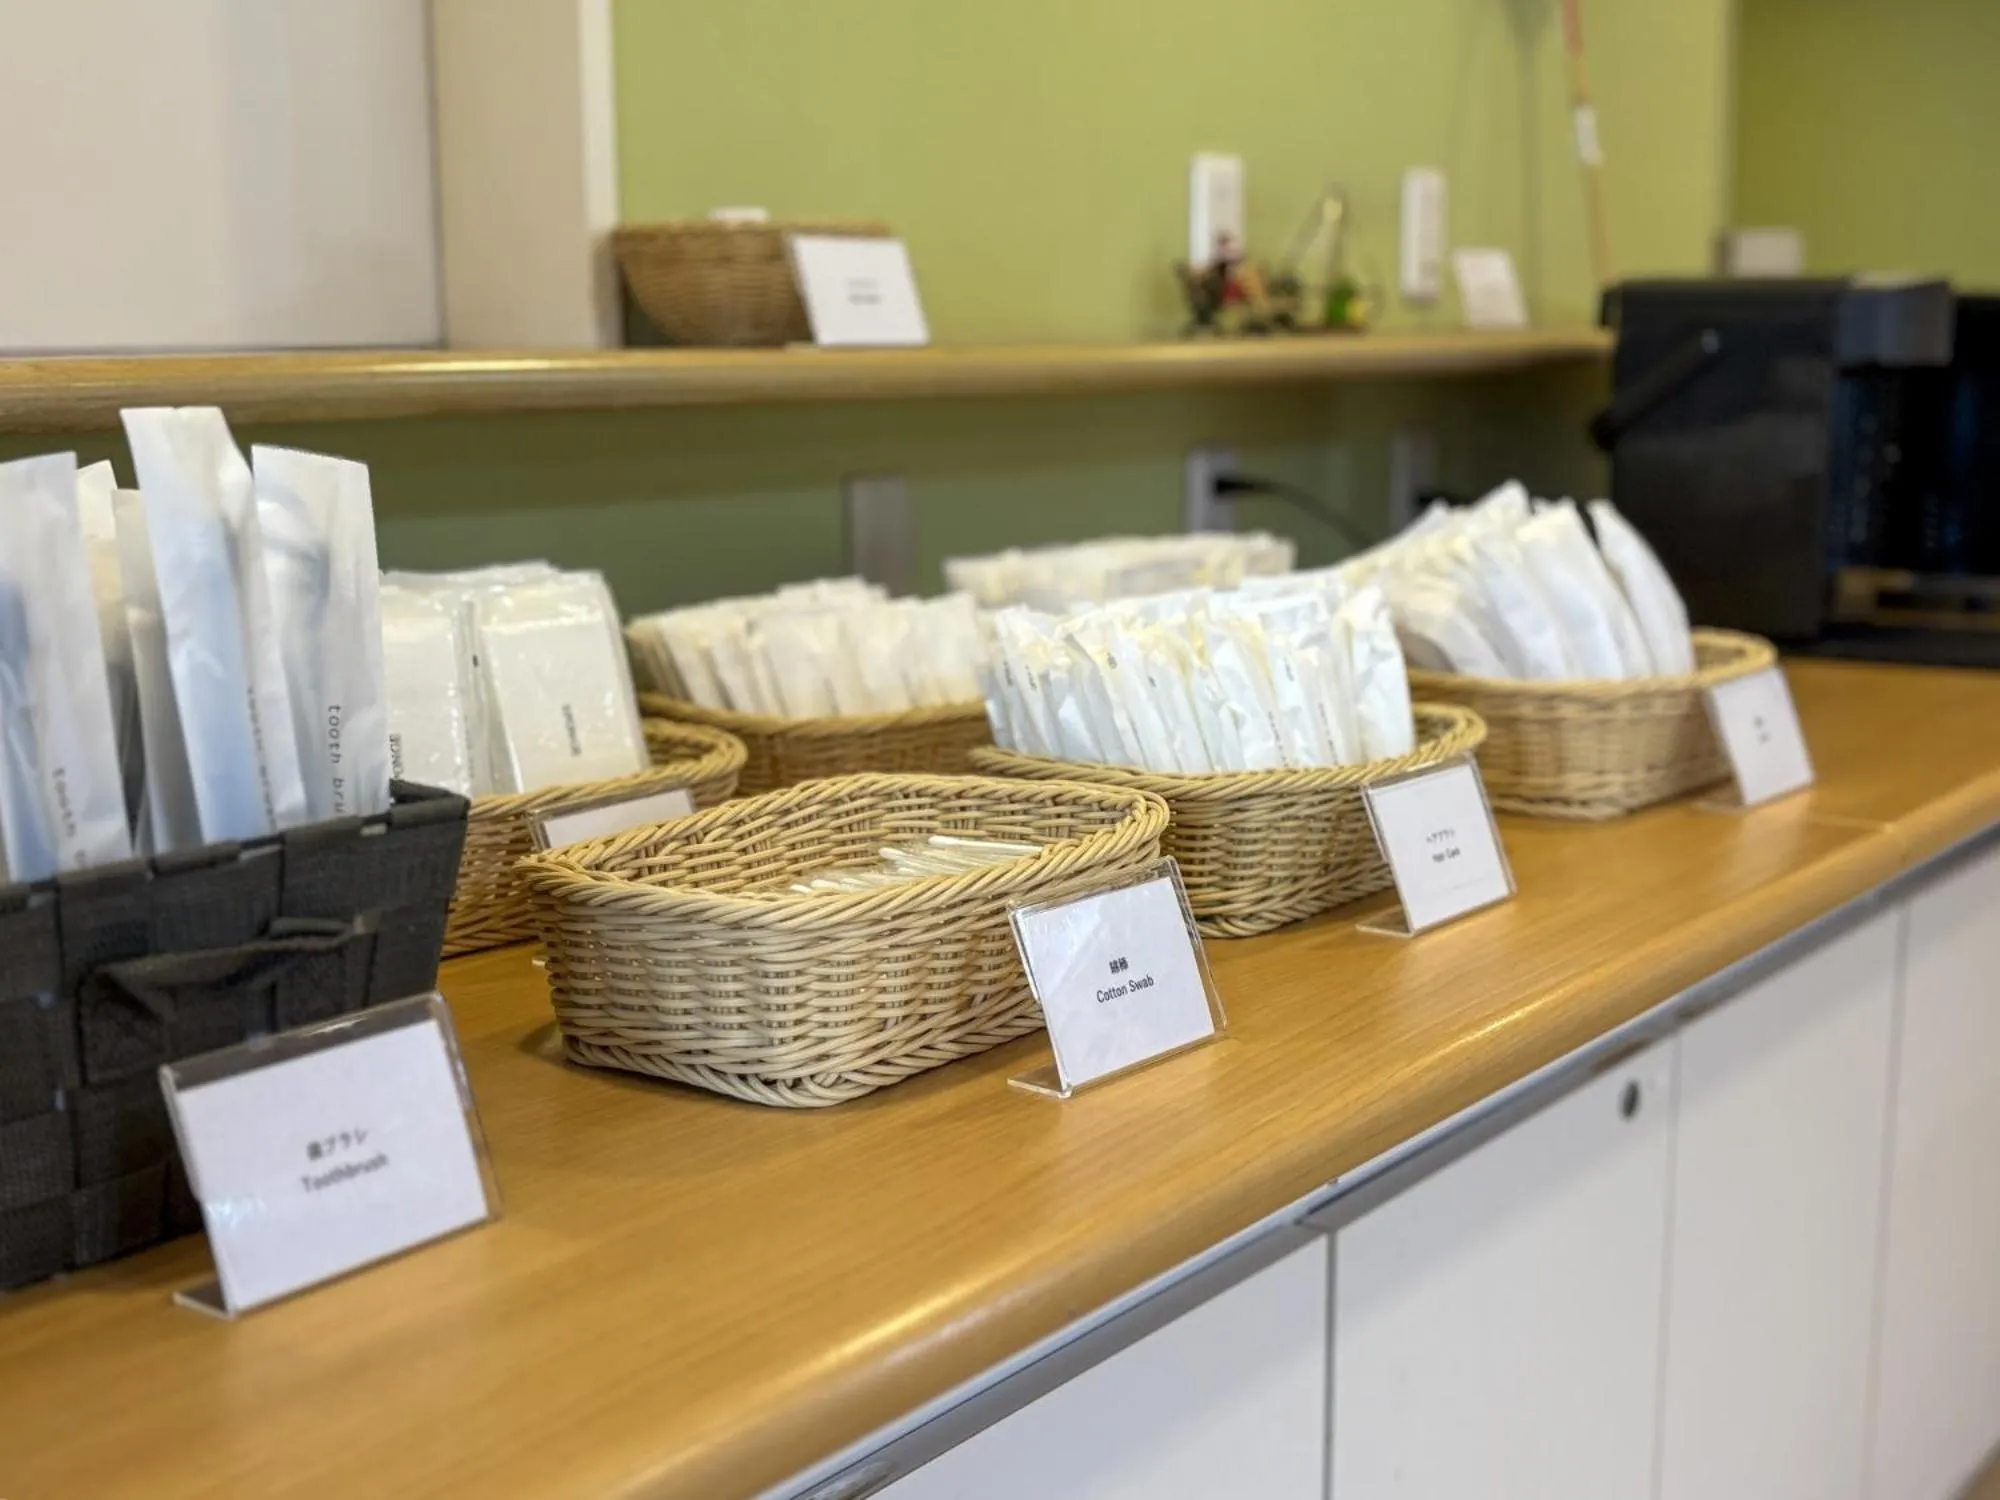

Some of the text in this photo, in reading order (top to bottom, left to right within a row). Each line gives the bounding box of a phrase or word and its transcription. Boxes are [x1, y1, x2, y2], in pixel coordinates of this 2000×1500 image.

[327, 703, 345, 814] tooth bru
[1096, 975, 1154, 1004] Cotton Swab
